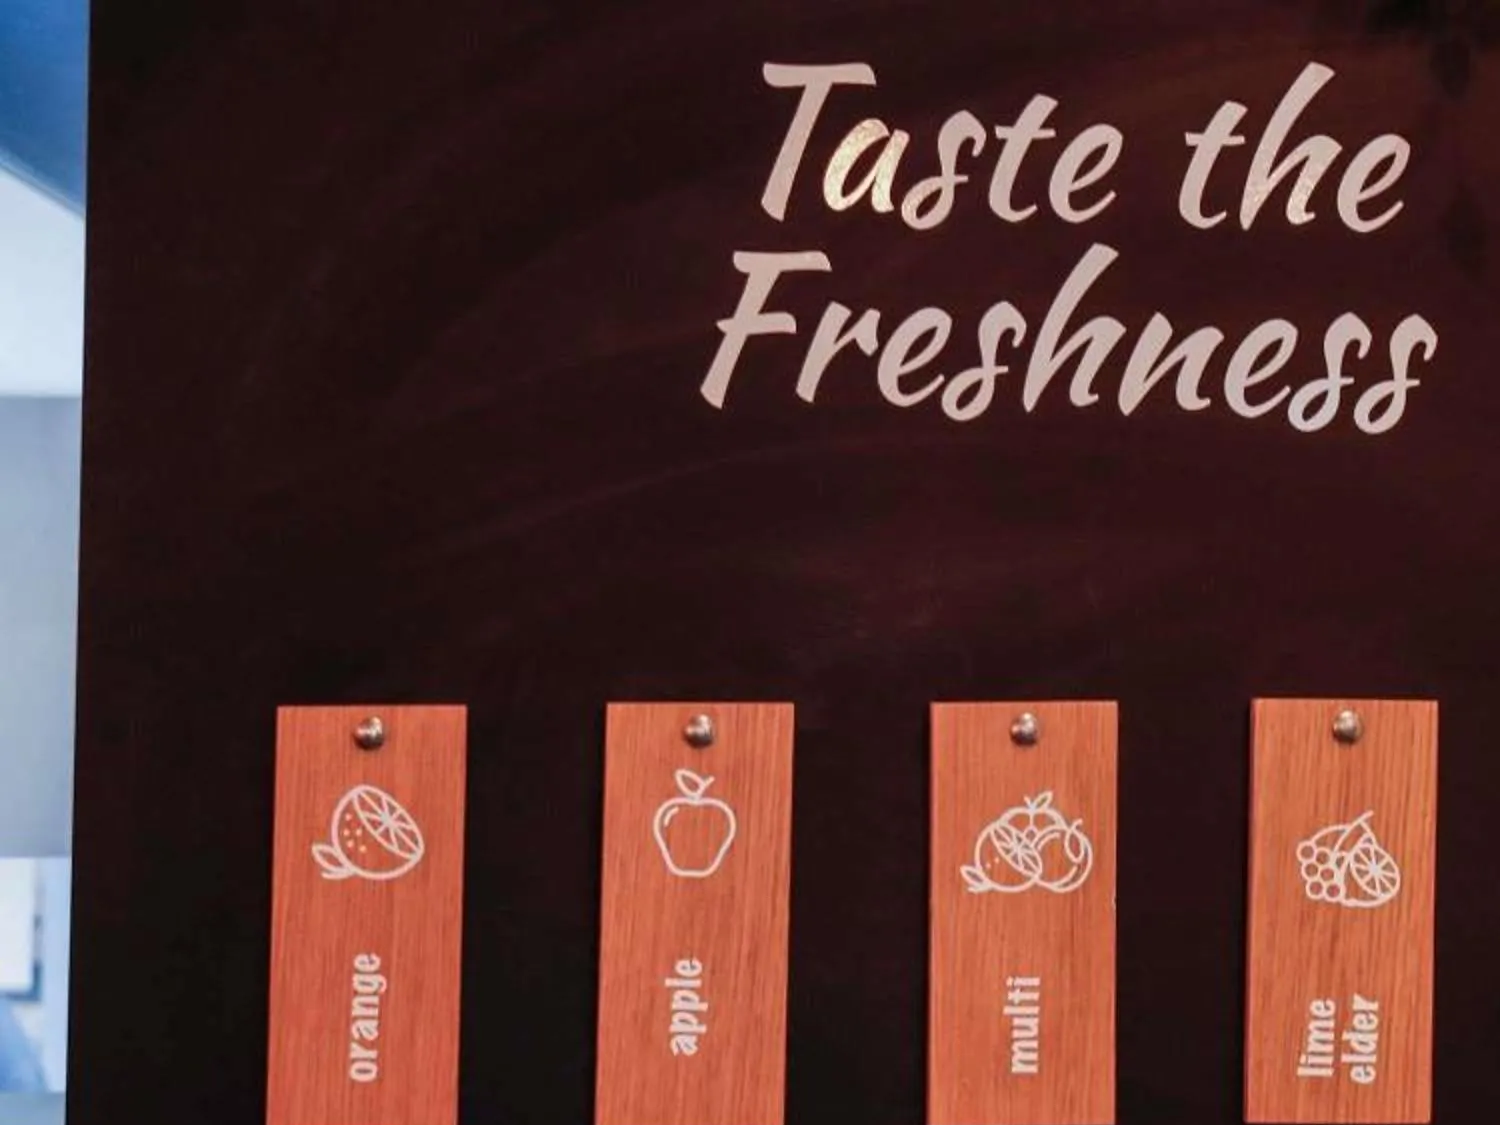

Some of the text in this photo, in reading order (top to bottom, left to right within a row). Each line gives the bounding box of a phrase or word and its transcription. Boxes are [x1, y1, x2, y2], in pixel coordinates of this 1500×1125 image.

[760, 61, 1412, 232] Taste the
[699, 243, 1439, 434] Freshness
[348, 952, 387, 1083] orange
[664, 957, 708, 1057] apple
[1003, 975, 1041, 1075] multi
[1297, 997, 1336, 1077] lime
[1340, 992, 1379, 1085] elder
